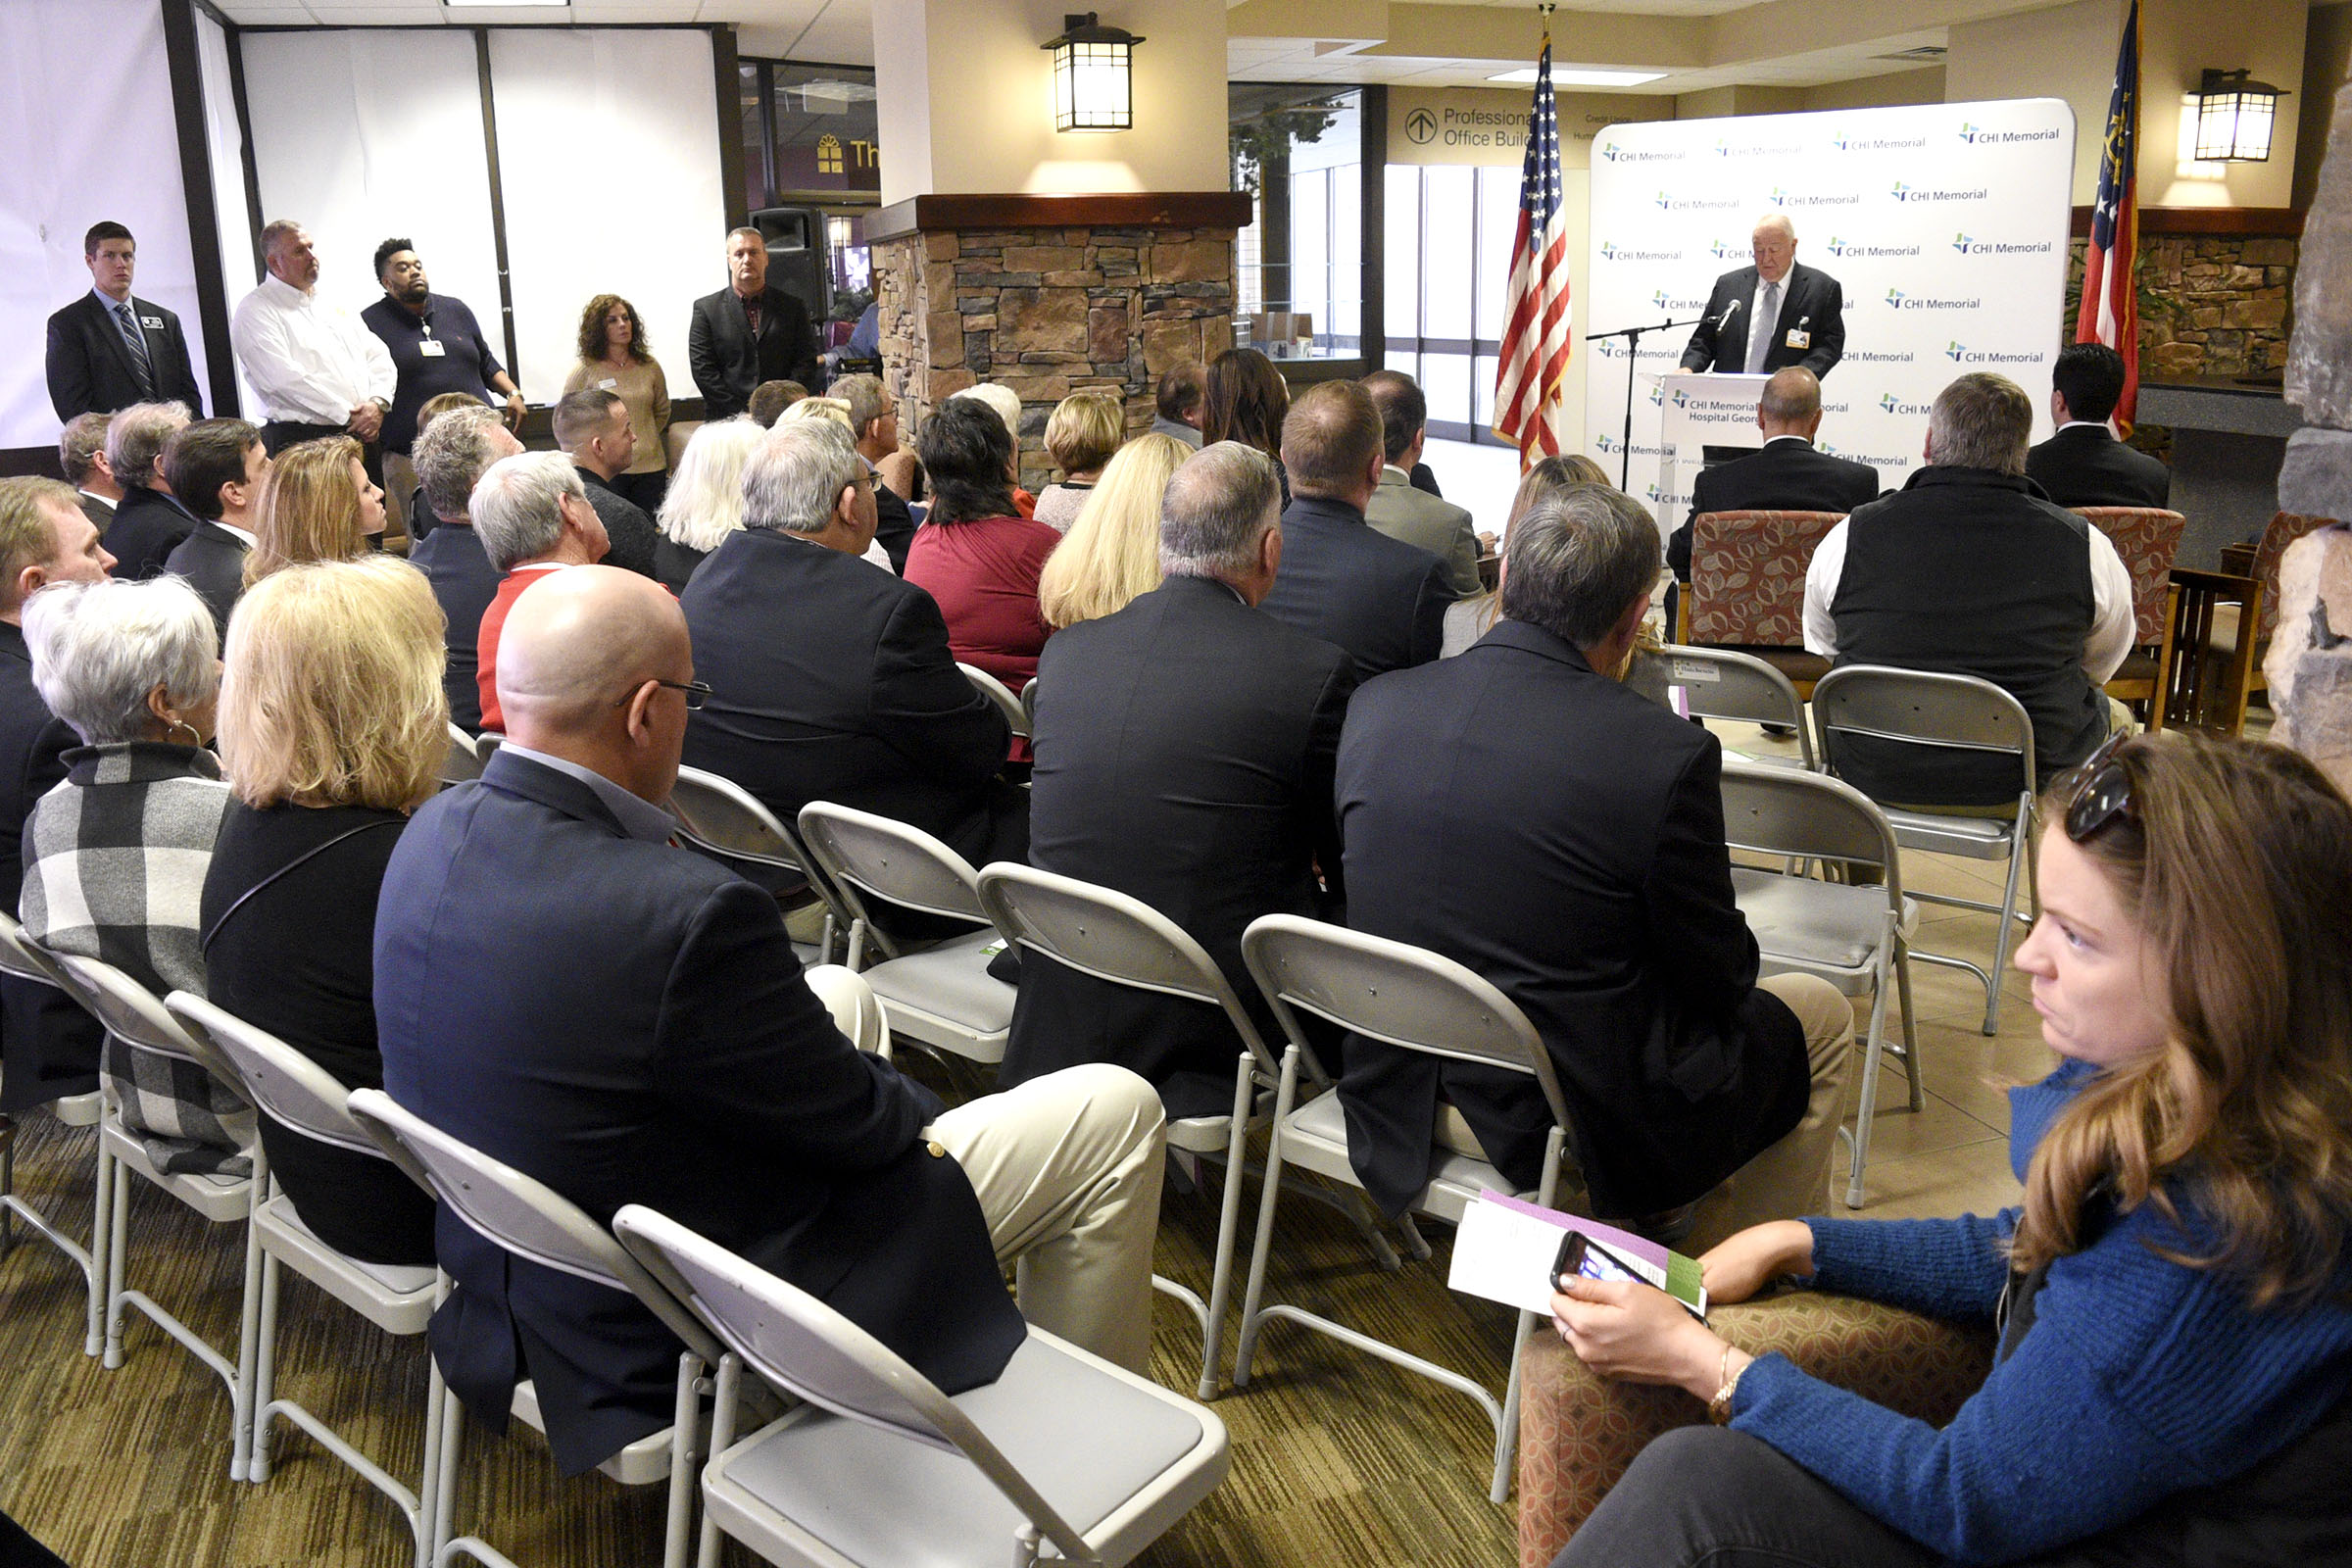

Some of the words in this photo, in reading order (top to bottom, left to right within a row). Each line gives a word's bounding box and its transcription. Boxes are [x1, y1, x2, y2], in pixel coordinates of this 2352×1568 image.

[1445, 108, 1532, 125] Professiona
[1445, 129, 1490, 146] Office
[1979, 133, 1999, 143] CHI
[2003, 127, 2060, 142] Memorial
[1851, 140, 1870, 150] CHI
[1874, 137, 1926, 149] Memorial
[850, 140, 880, 169] Th
[1619, 152, 1637, 162] CHI
[1640, 151, 1686, 162] Memorial
[1788, 197, 1806, 206] CHI
[1809, 193, 1860, 205] Memorial
[1910, 191, 1930, 202] CHI
[1934, 188, 1987, 201] Memorial
[1672, 200, 1690, 210] CHI
[1692, 199, 1740, 210] Memorial
[1846, 247, 1865, 257] CHI
[1868, 245, 1921, 257] Memorial
[1972, 243, 1992, 254] CHI
[1996, 241, 2052, 254] Memorial
[1617, 251, 1634, 260] CHI
[1637, 250, 1682, 260] Memorial
[1728, 250, 1745, 259] CHI
[1670, 300, 1687, 310] CHI
[1904, 299, 1924, 309] CHI
[1927, 297, 1981, 309] Memorial
[1635, 349, 1679, 359] Memorial
[1841, 352, 1860, 362] CHI
[1862, 351, 1914, 362] Memorial
[1965, 352, 1985, 363] CHI
[1988, 351, 2044, 364] Memorial
[1690, 400, 1707, 410] CHI
[1710, 400, 1758, 412] Memorial
[1821, 403, 1848, 413] orial
[1898, 405, 1917, 415] CHI
[1690, 413, 1730, 423] Hospital
[1612, 445, 1624, 454] CH
[1631, 445, 1677, 456] Memoial
[1857, 454, 1908, 466] Memorial
